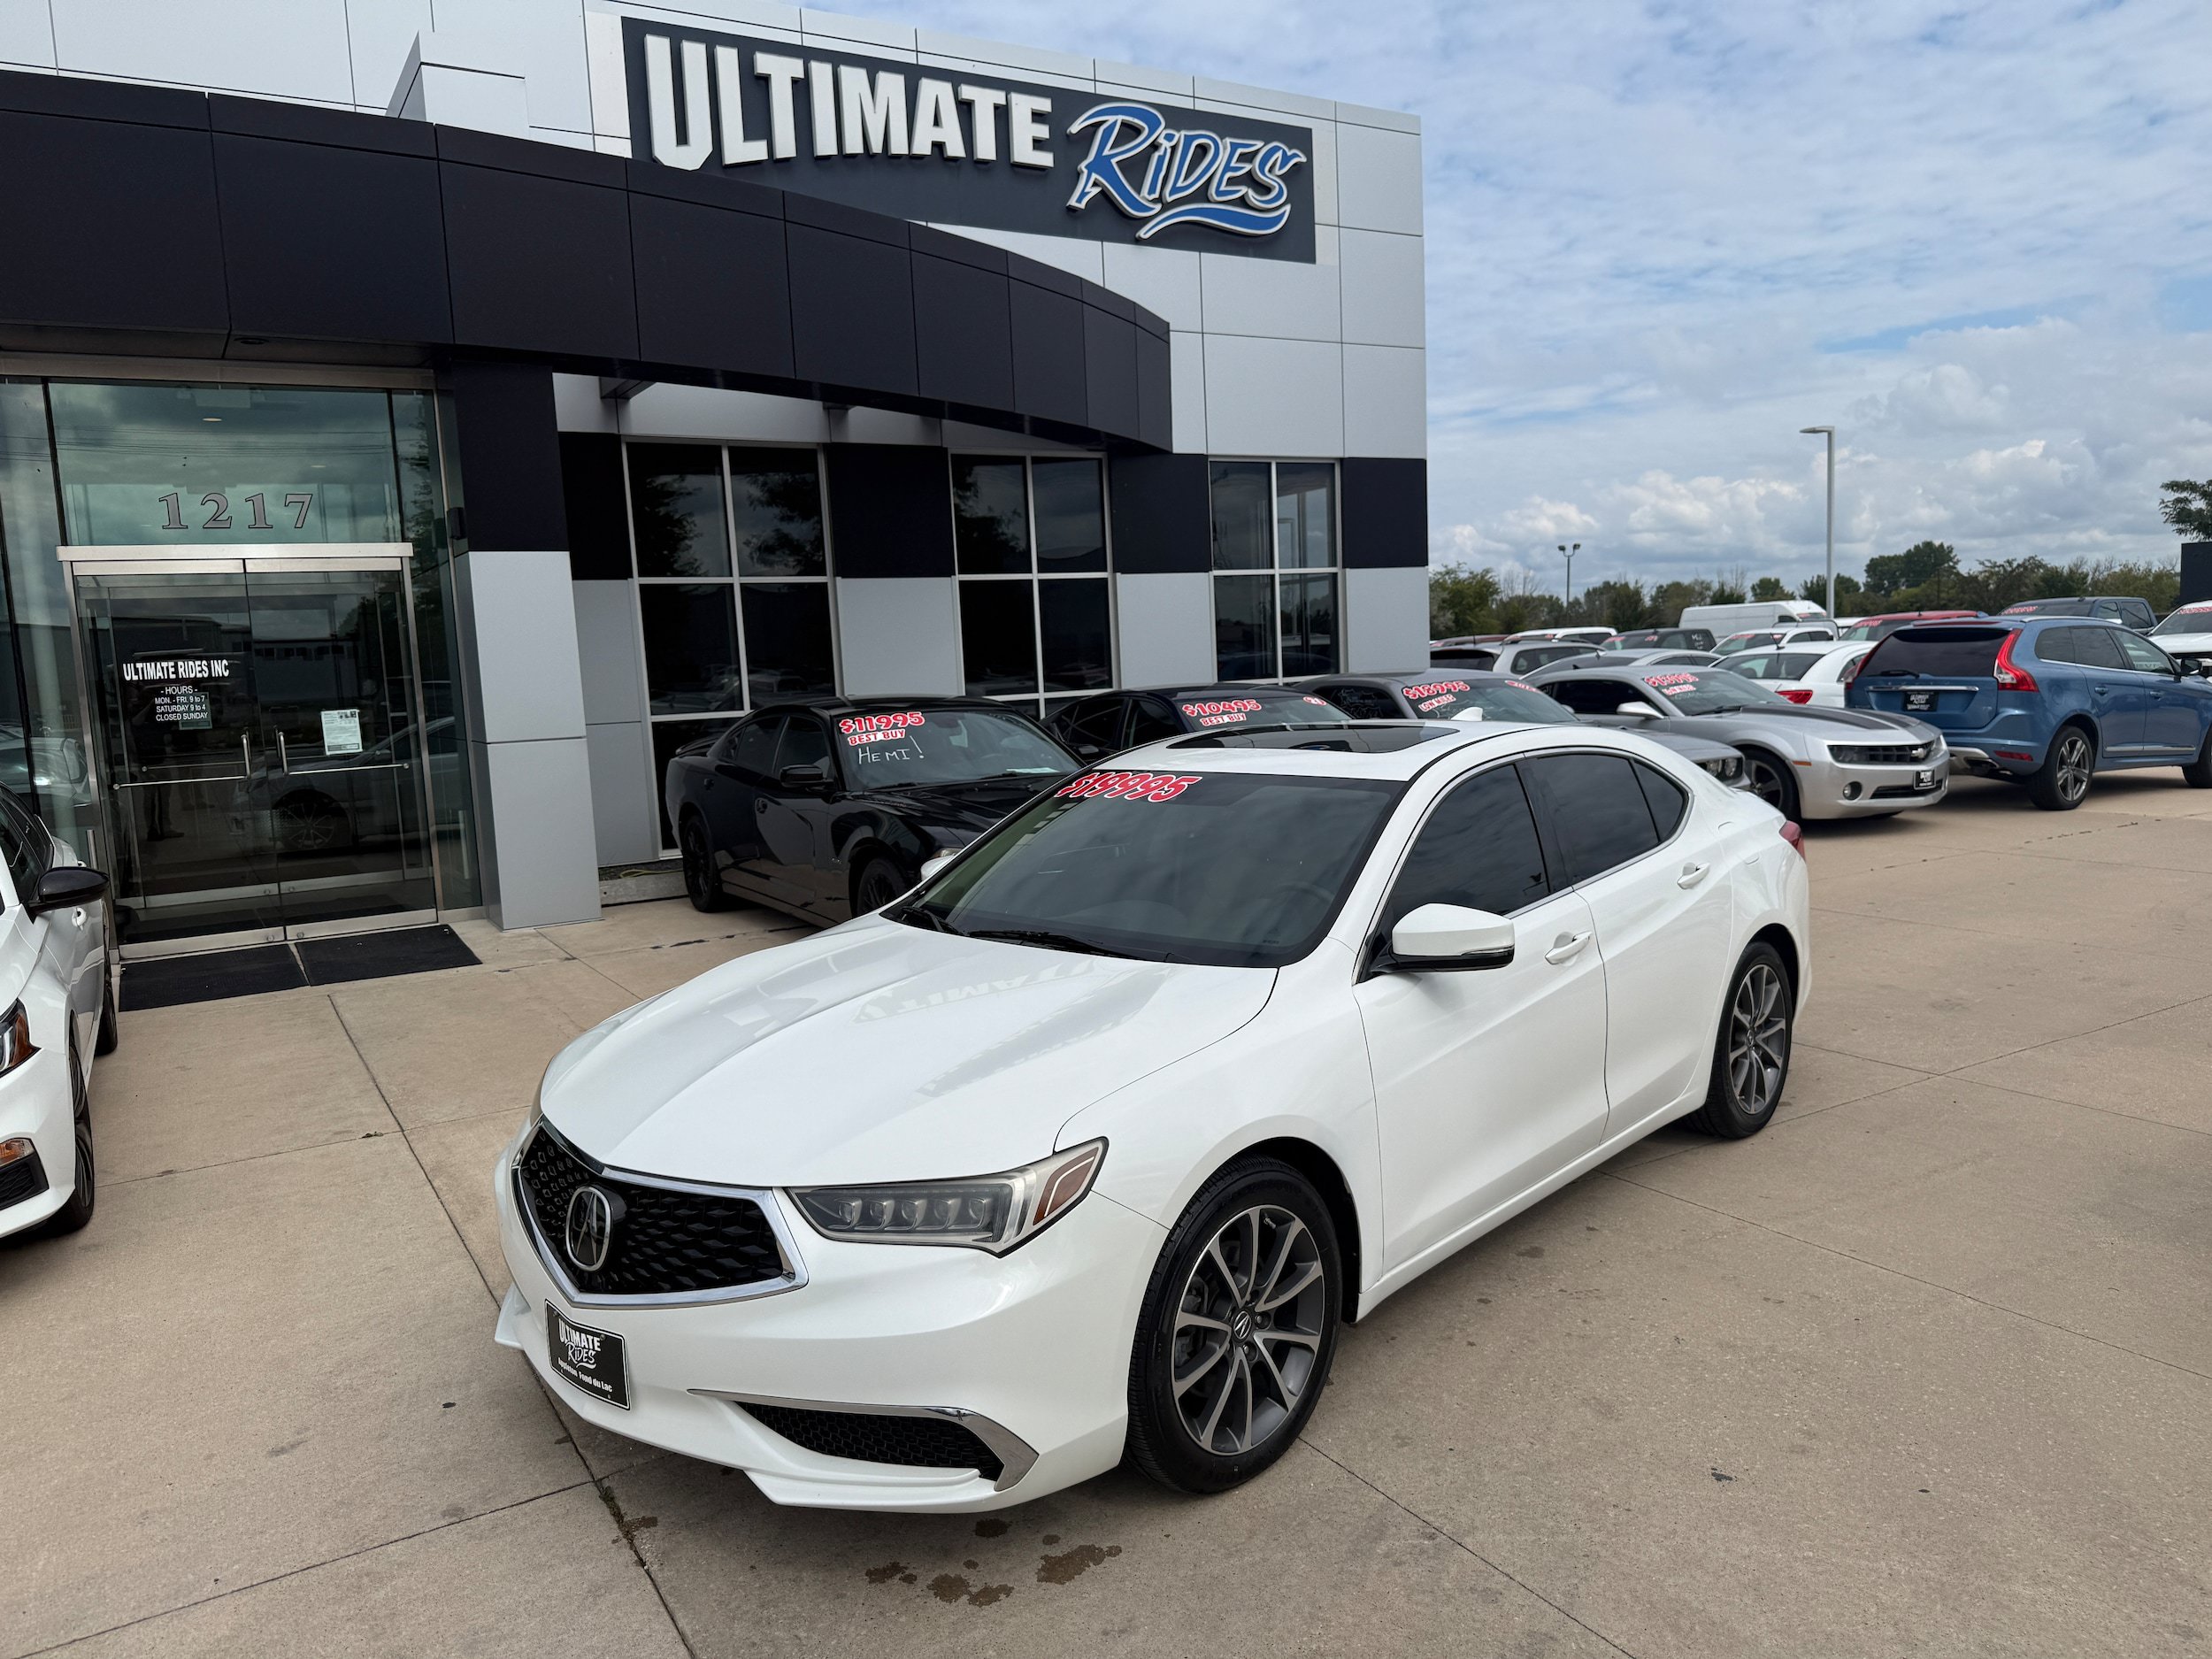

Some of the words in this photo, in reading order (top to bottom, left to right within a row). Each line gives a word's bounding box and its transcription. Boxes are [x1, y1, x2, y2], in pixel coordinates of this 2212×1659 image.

[644, 34, 1055, 171] ULTIMATE
[157, 492, 312, 530] 1217
[123, 661, 176, 680] ULTIMATE
[178, 660, 209, 679] RIDES
[211, 659, 229, 677] INC
[165, 686, 193, 695] HOURS
[156, 704, 189, 713] SATURDAY
[156, 713, 182, 722] CLOSED
[183, 711, 209, 720] SUNDAY
[1182, 699, 1262, 717] $10495
[839, 711, 926, 733] $11995
[1200, 715, 1225, 727] BEST
[1227, 712, 1247, 724] BUY
[848, 732, 879, 746] BEST
[881, 728, 906, 741] BUY
[1054, 772, 1203, 803] $19995
[558, 1317, 602, 1352] ULTIMATE
[593, 1378, 602, 1389] du
[602, 1380, 613, 1393] Lac
